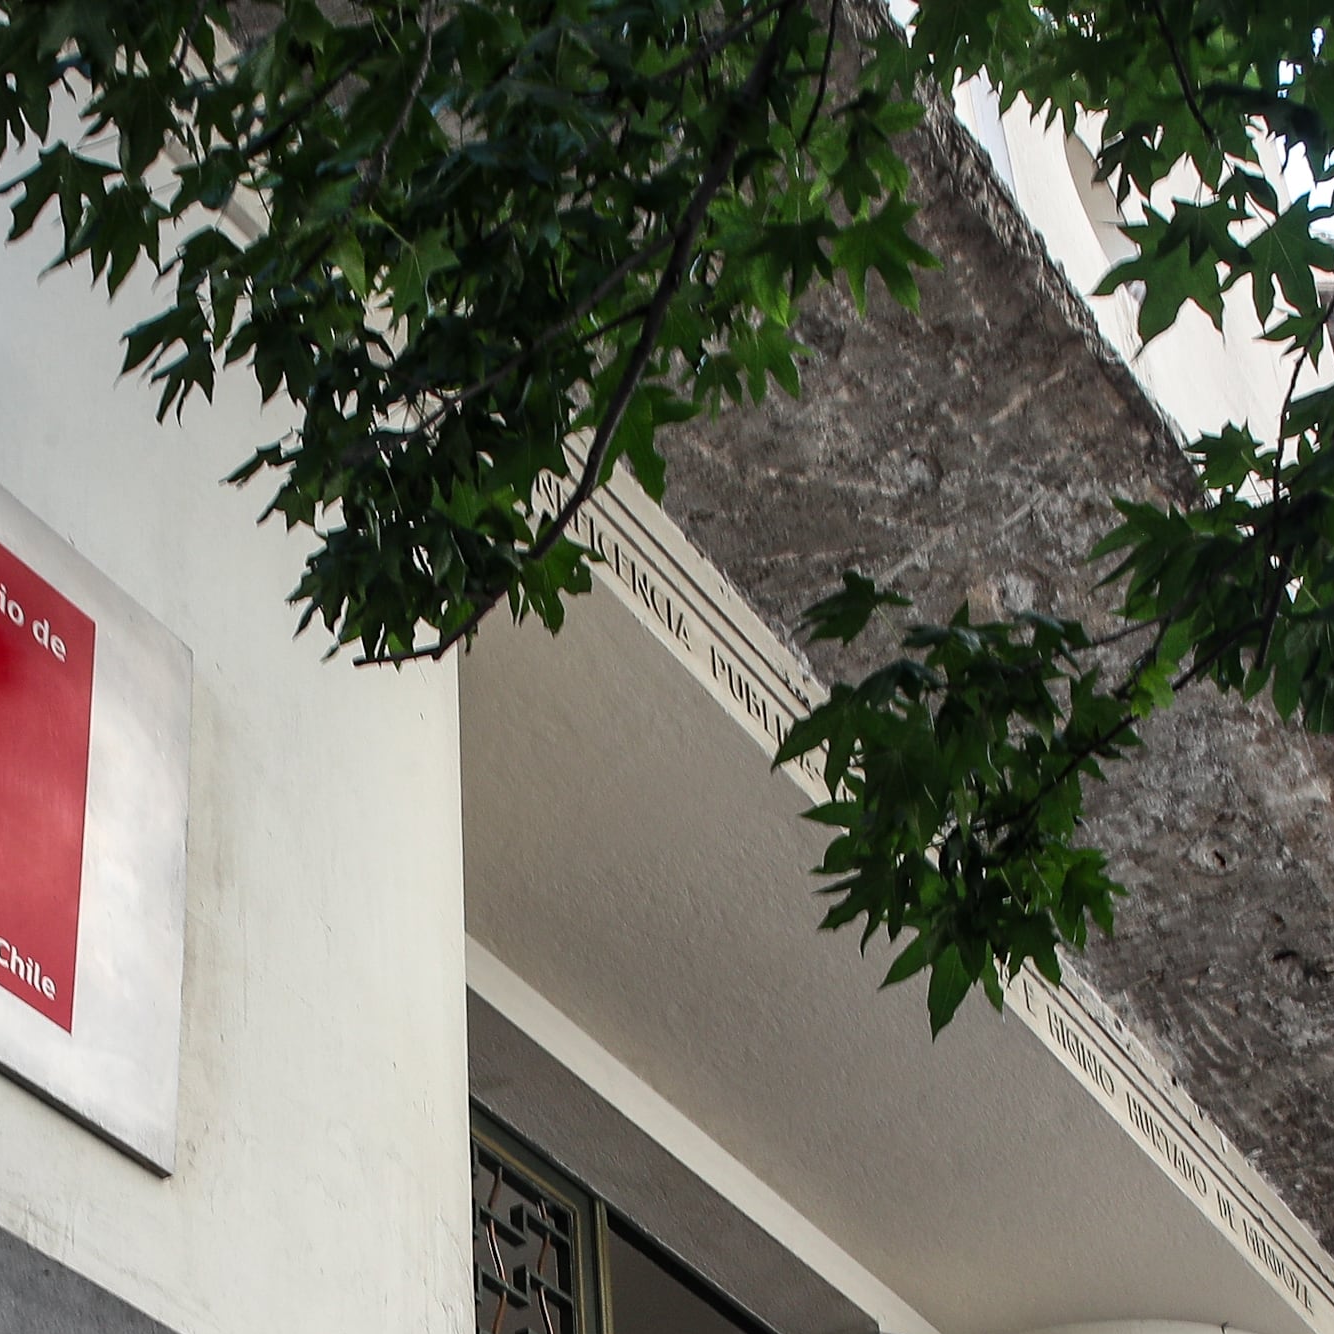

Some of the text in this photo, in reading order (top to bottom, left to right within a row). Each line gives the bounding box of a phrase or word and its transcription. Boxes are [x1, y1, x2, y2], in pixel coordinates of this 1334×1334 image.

[31, 618, 67, 662] de
[1126, 1091, 1207, 1198] HURTADO
[1216, 1189, 1237, 1233] DE
[1242, 1217, 1313, 1316] MENDOZA
